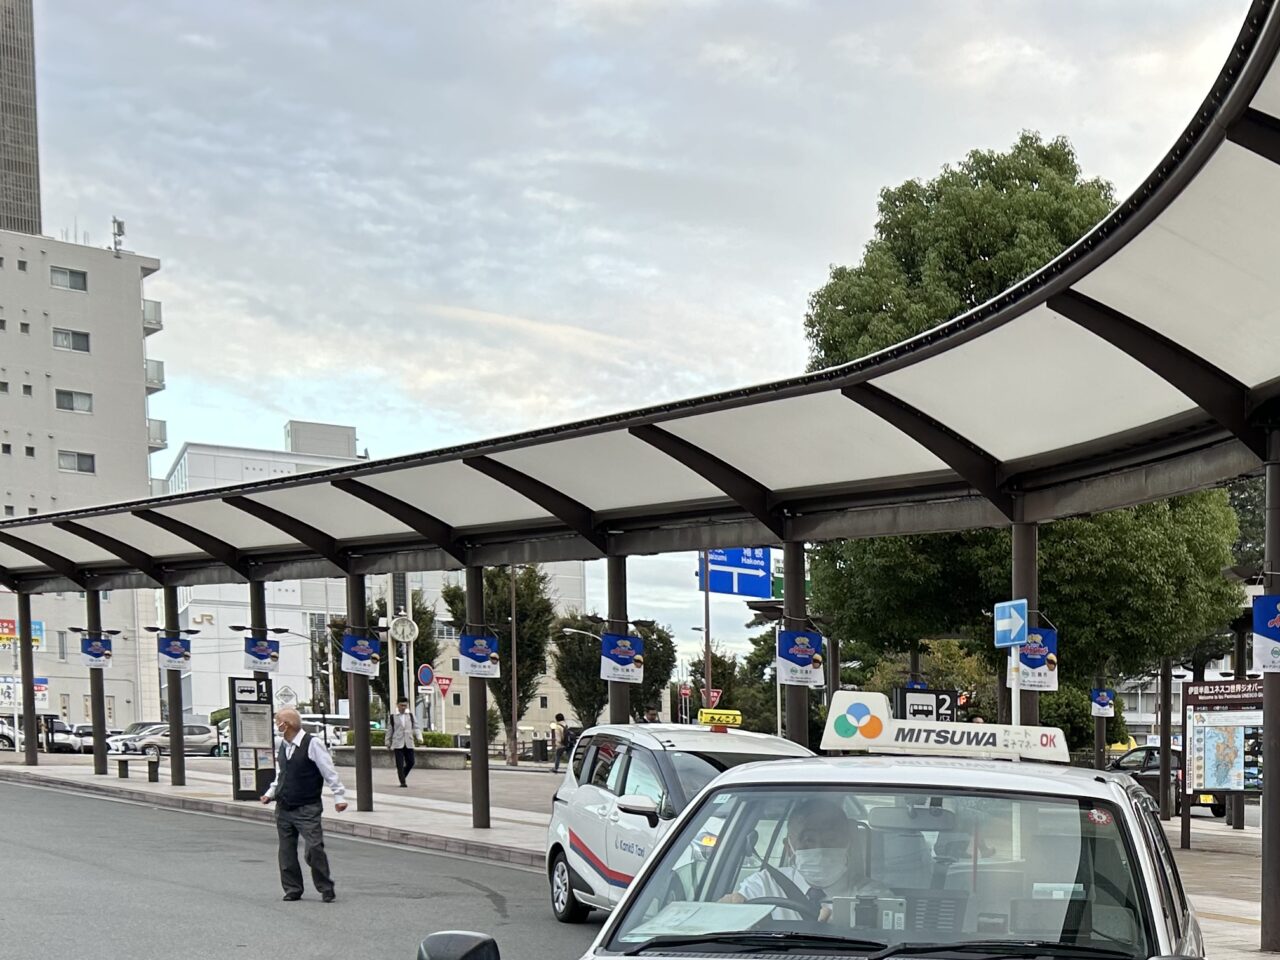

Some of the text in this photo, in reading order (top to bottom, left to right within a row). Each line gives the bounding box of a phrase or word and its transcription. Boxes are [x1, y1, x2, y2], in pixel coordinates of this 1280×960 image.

[741, 557, 765, 566] Hakone
[192, 614, 214, 625] JR
[259, 681, 267, 693] 1
[939, 695, 951, 714] 2
[894, 727, 997, 747] MITSUWA
[1040, 733, 1056, 747] OK
